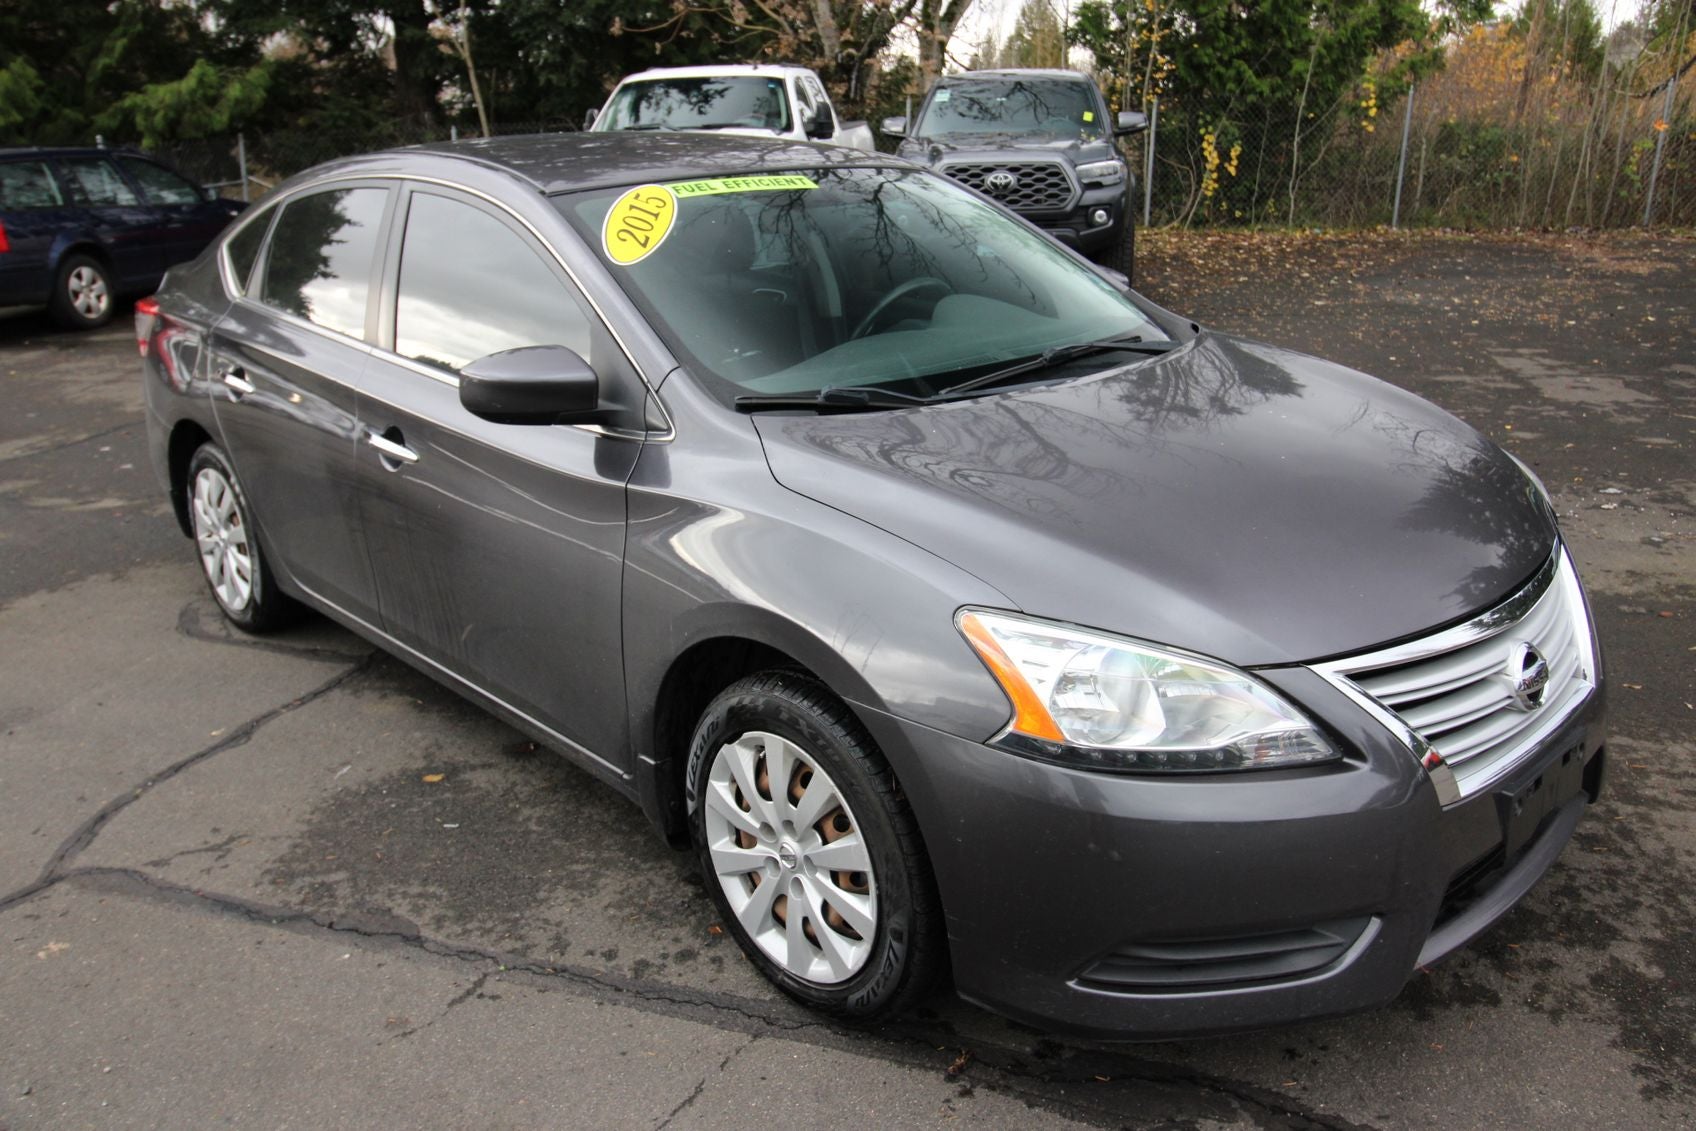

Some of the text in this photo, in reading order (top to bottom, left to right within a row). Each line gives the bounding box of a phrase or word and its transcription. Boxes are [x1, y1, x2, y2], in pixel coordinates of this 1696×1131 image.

[672, 177, 807, 194] FUEL EFFICIENT
[616, 192, 667, 249] 2015
